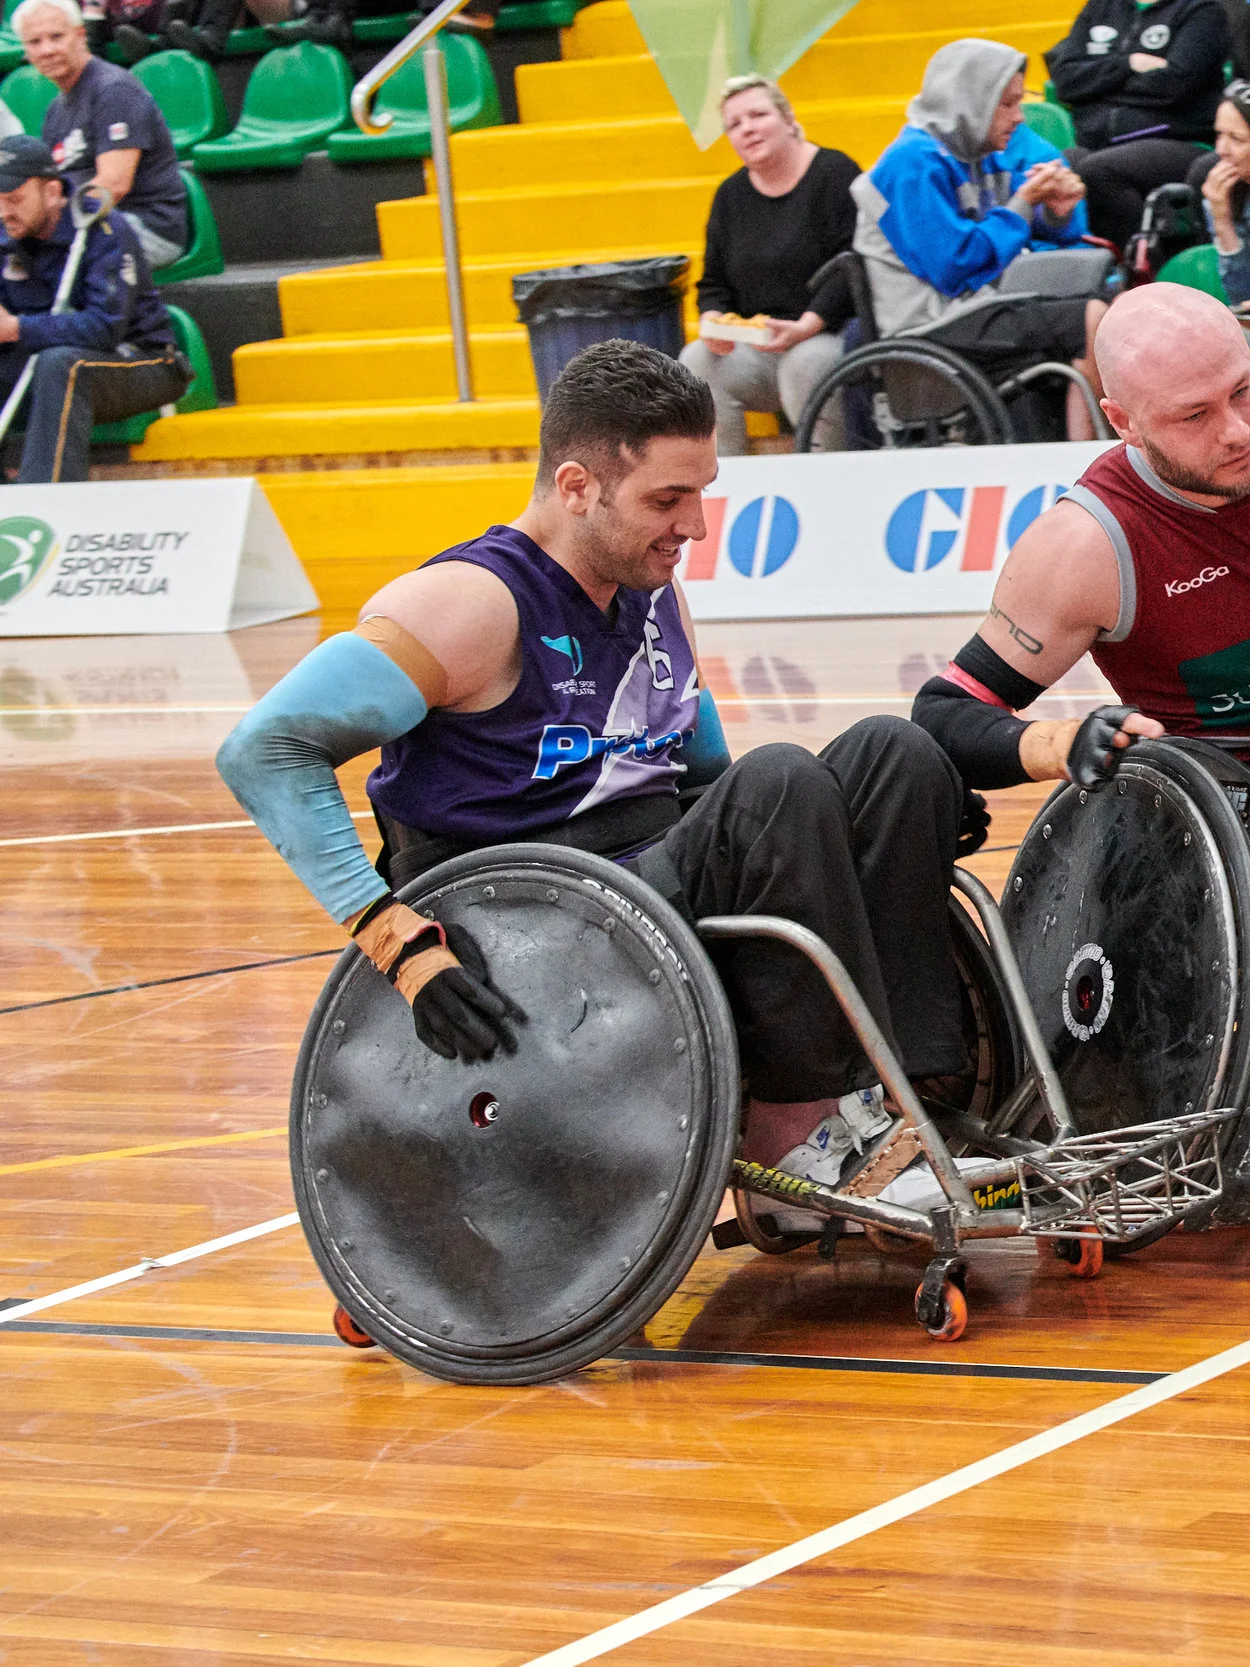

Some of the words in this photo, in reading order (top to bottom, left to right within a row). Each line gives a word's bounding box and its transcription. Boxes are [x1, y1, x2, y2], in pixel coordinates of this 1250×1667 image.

[65, 531, 190, 553] DISABILITY
[684, 495, 801, 581] IO
[57, 556, 154, 576] SPORTS
[48, 577, 170, 597] AUSTRALIA
[1165, 566, 1230, 598] KooGa
[644, 617, 675, 691] 6
